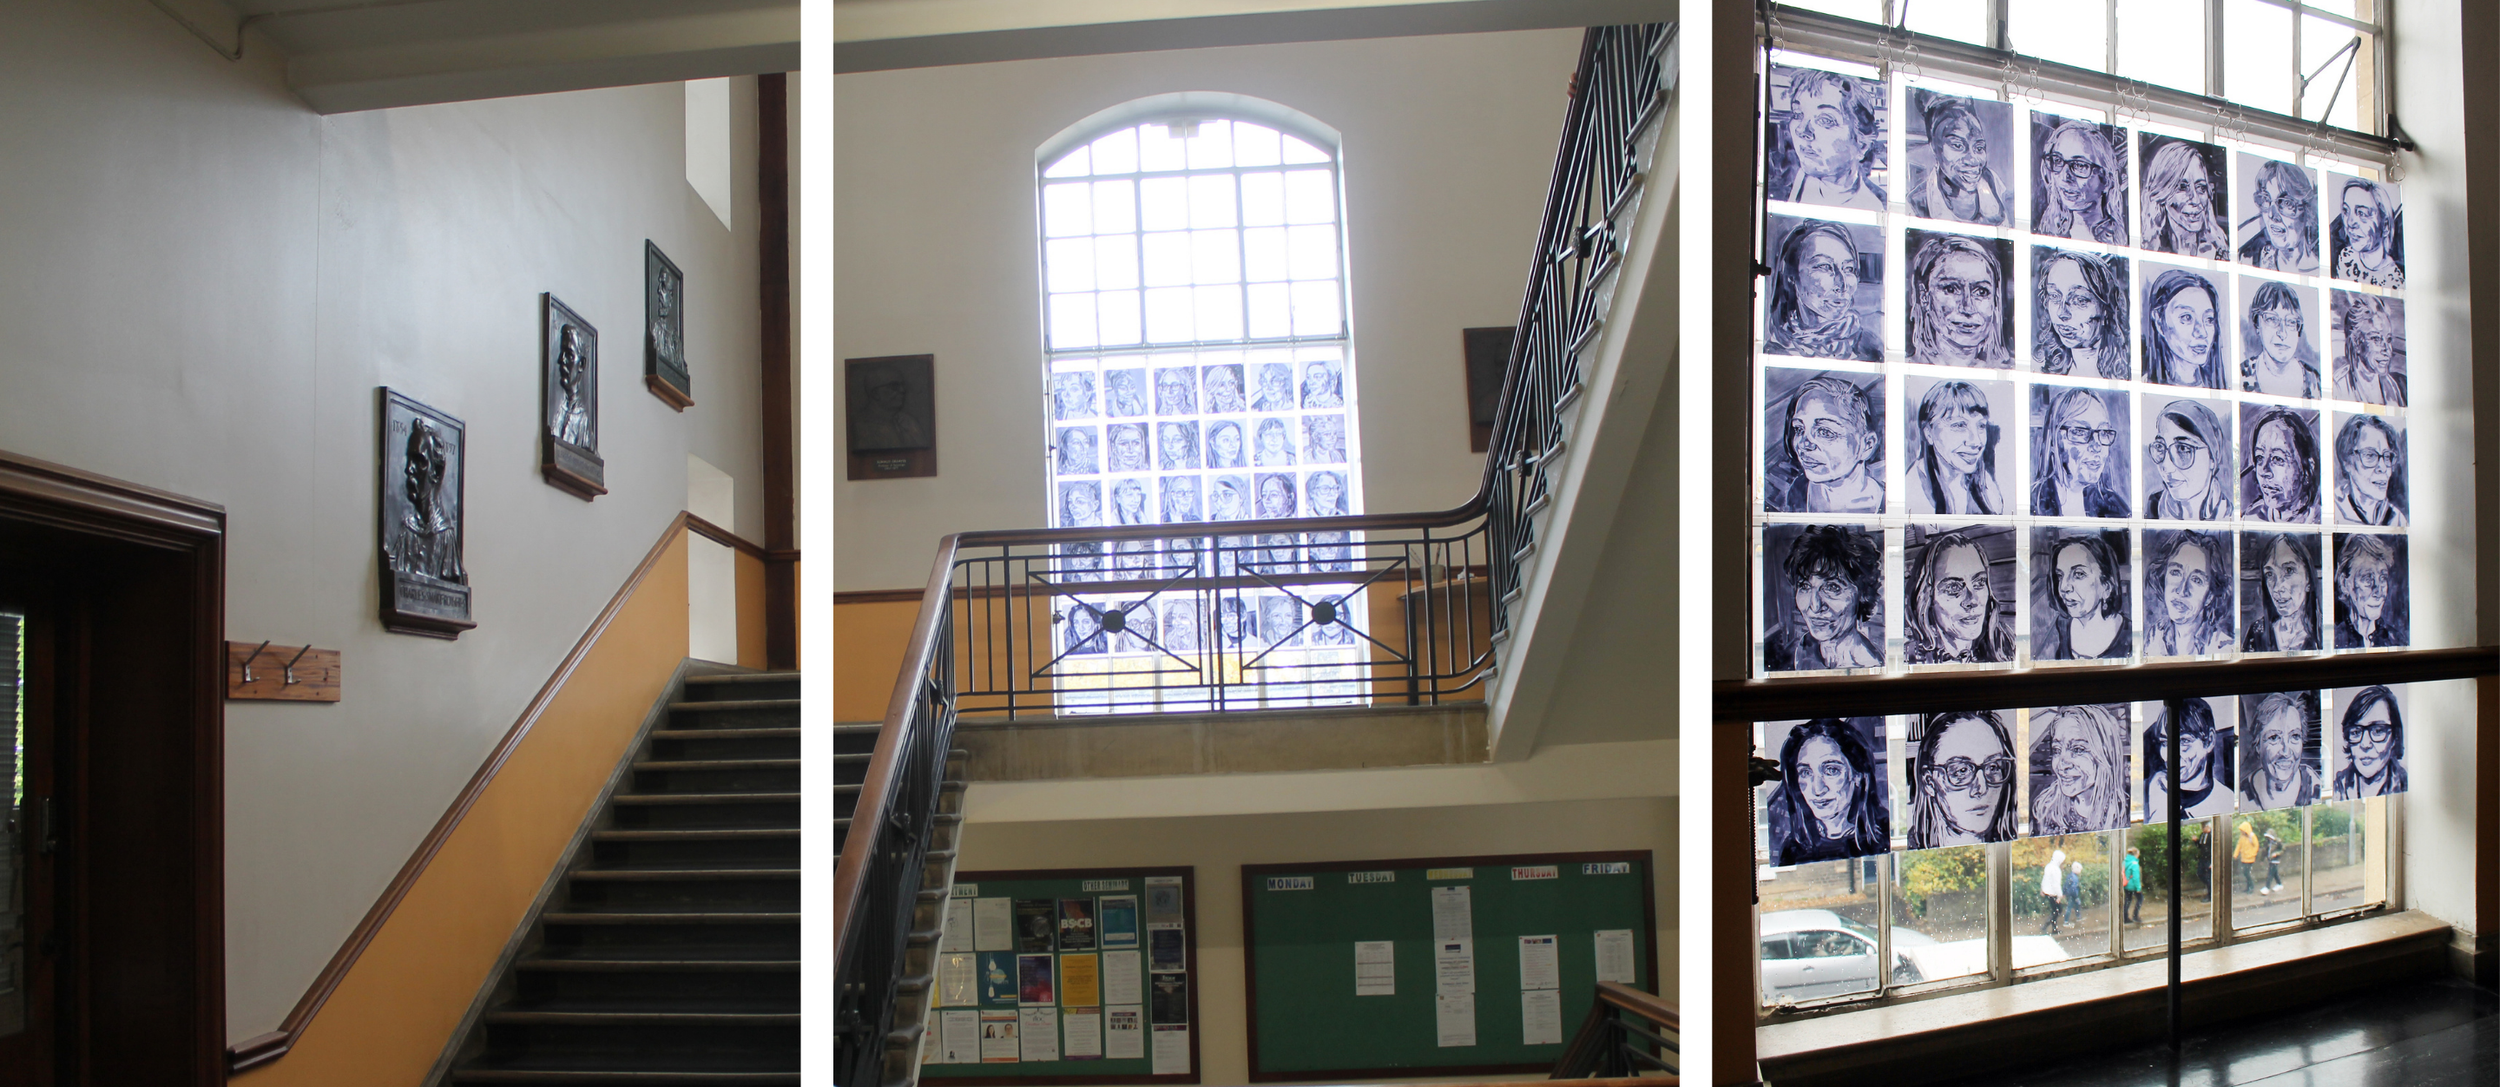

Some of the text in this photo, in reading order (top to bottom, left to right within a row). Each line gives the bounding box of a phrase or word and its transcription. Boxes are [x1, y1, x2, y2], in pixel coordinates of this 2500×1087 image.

[1427, 868, 1473, 880] WEDNESDAY
[1512, 867, 1557, 880] THURSDAY
[1583, 863, 1628, 874] FRIDAY
[1349, 872, 1394, 883] TUESDAY
[1083, 880, 1101, 891] OTHER
[1268, 878, 1312, 890] MONDAY
